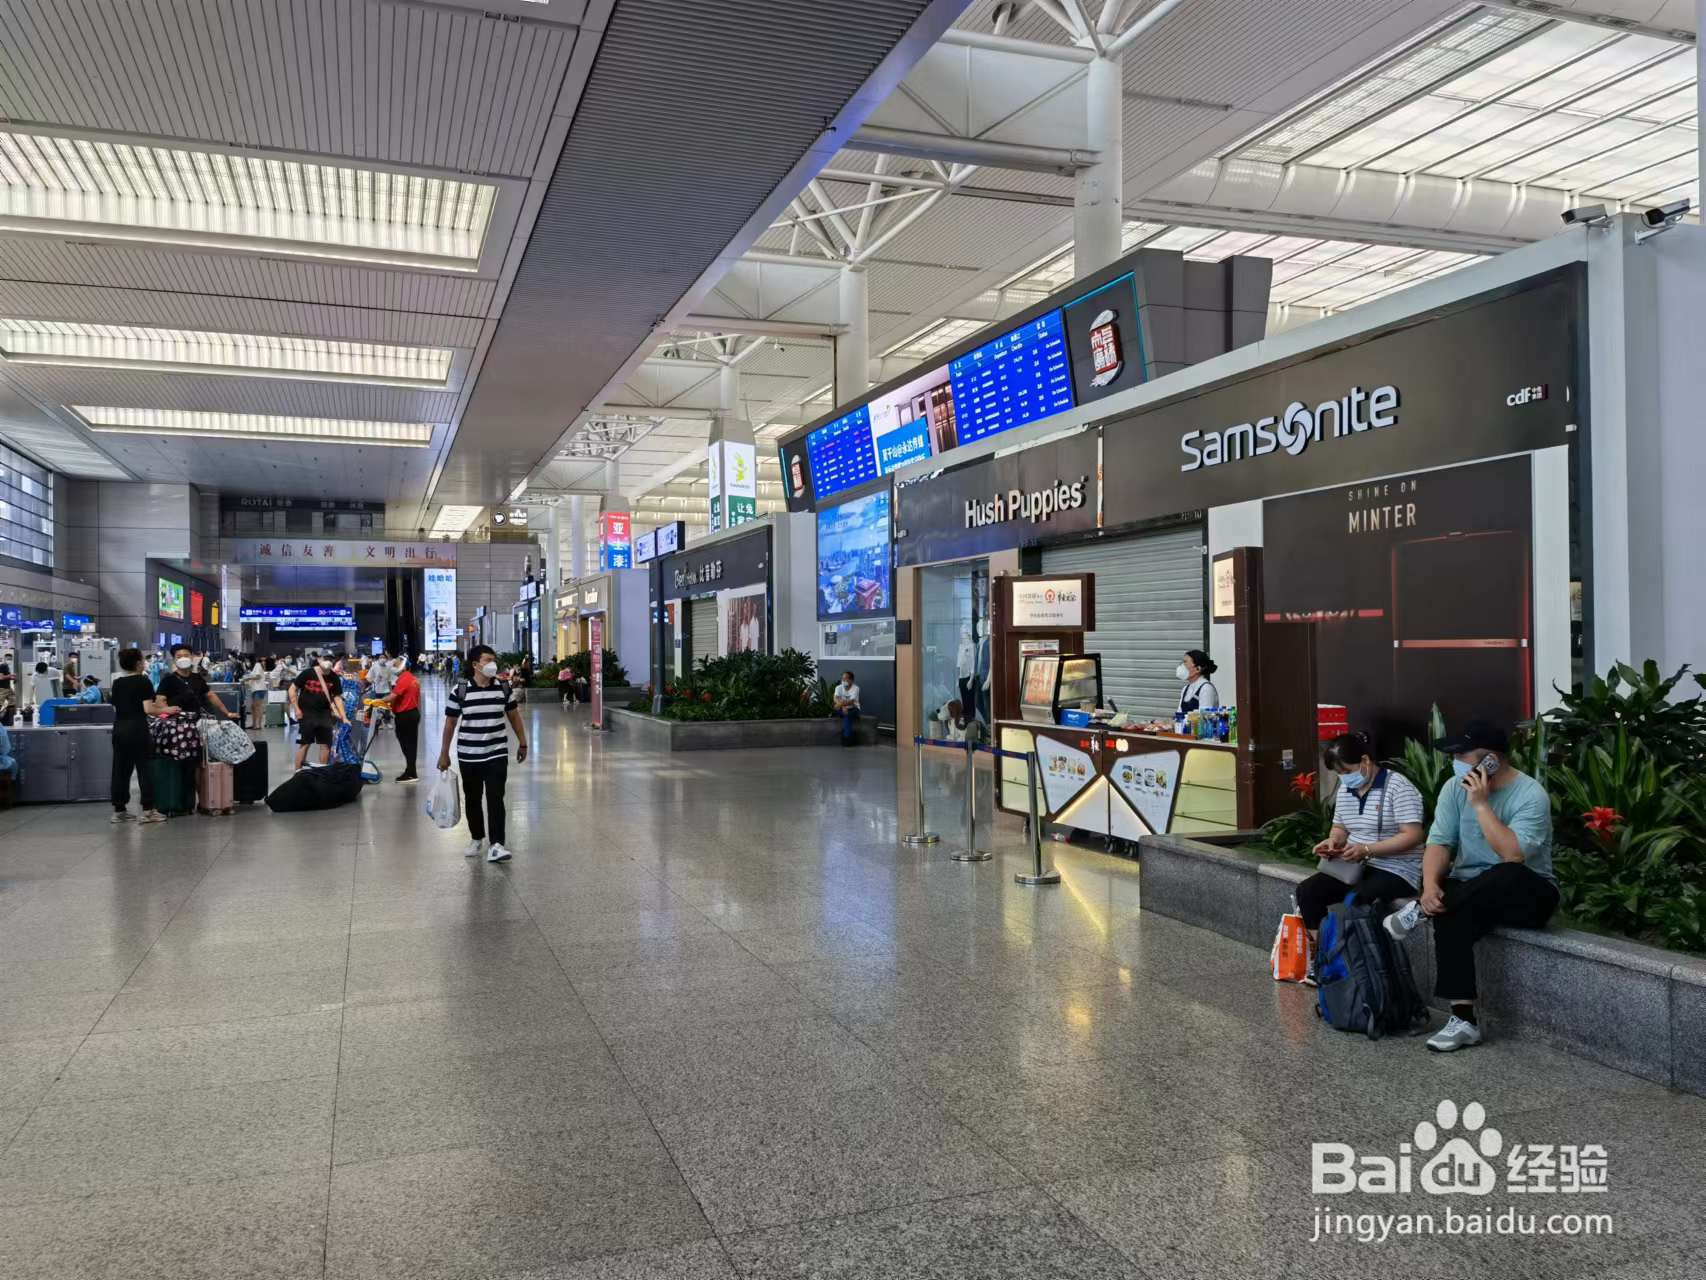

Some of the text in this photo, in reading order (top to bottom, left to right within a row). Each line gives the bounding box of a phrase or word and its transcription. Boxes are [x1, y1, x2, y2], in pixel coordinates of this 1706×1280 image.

[1181, 386, 1397, 471] Samsonite
[965, 479, 1083, 529] Hush Puppies
[1348, 480, 1417, 501] SHINE ON
[1348, 503, 1416, 534] MINTER
